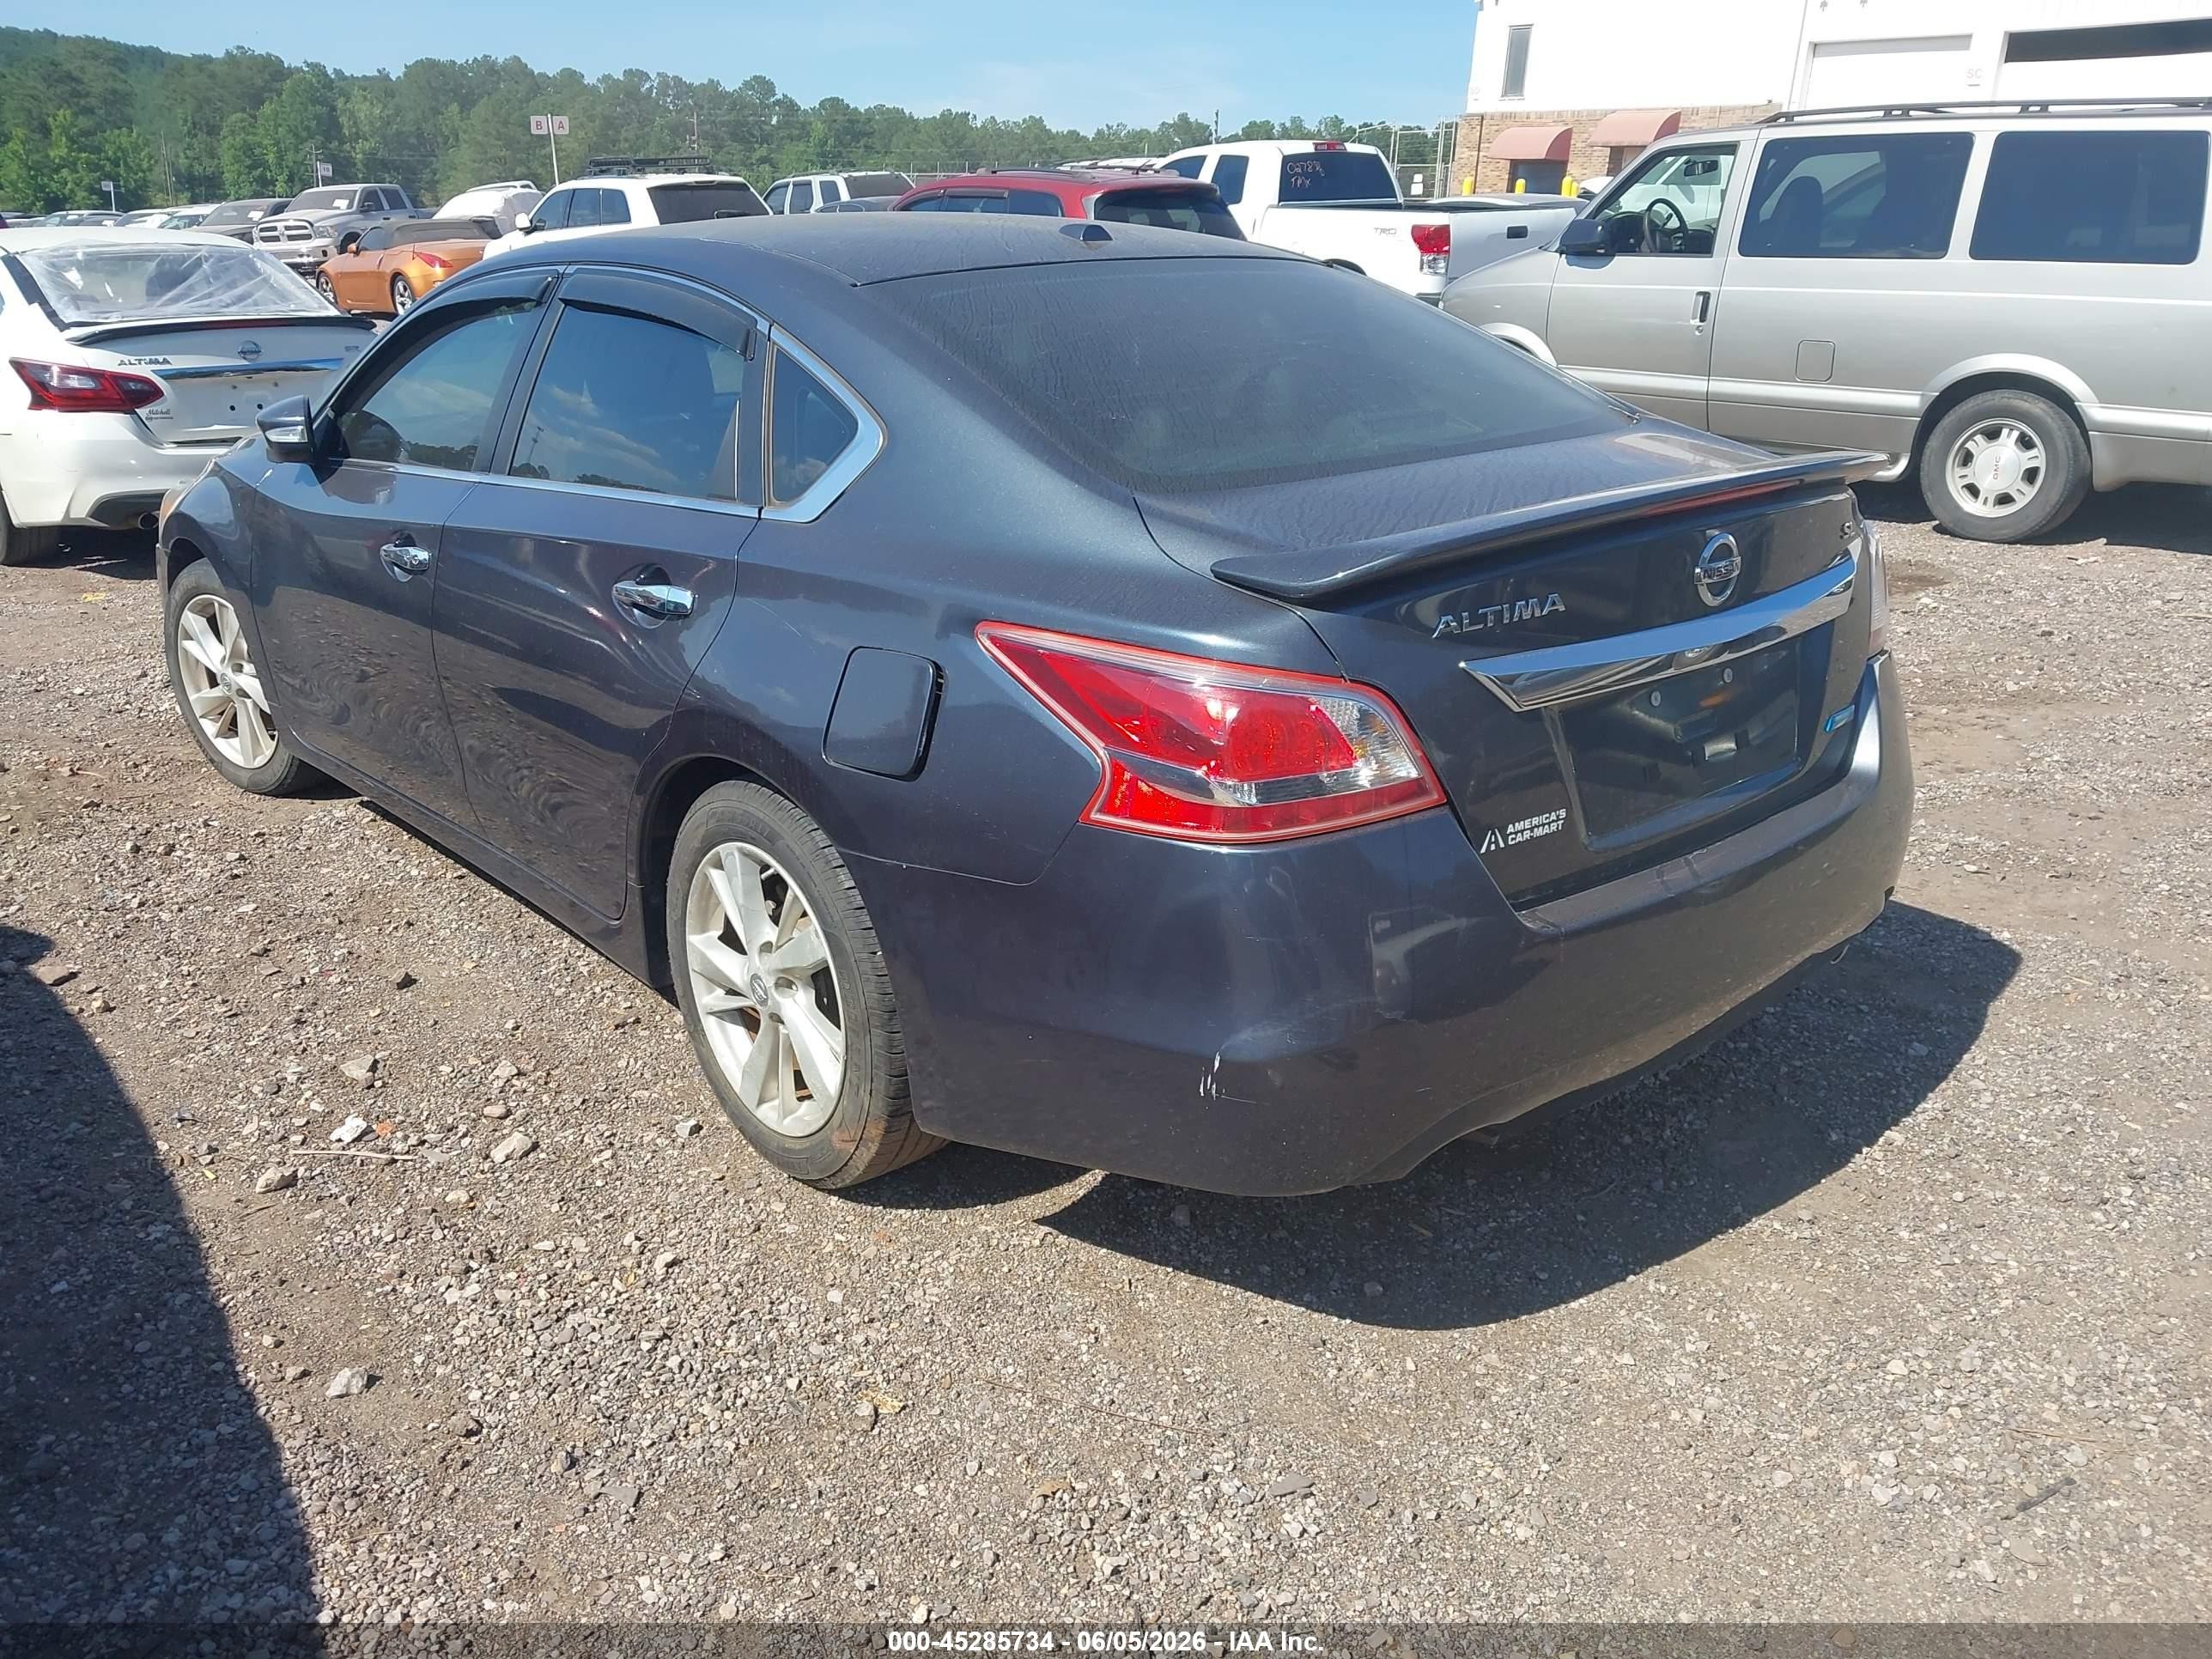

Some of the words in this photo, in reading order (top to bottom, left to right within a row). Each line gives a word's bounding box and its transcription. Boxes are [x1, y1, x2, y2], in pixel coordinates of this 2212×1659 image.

[535, 120, 543, 131] B
[557, 120, 565, 131] A
[118, 357, 173, 367] ALTIMA
[1992, 456, 2001, 480] GMC
[1702, 557, 1740, 580] NISSAN
[1431, 593, 1565, 639] ALTIMA
[1506, 808, 1567, 835] AMERICA'S
[1508, 820, 1565, 845] CAR-MART
